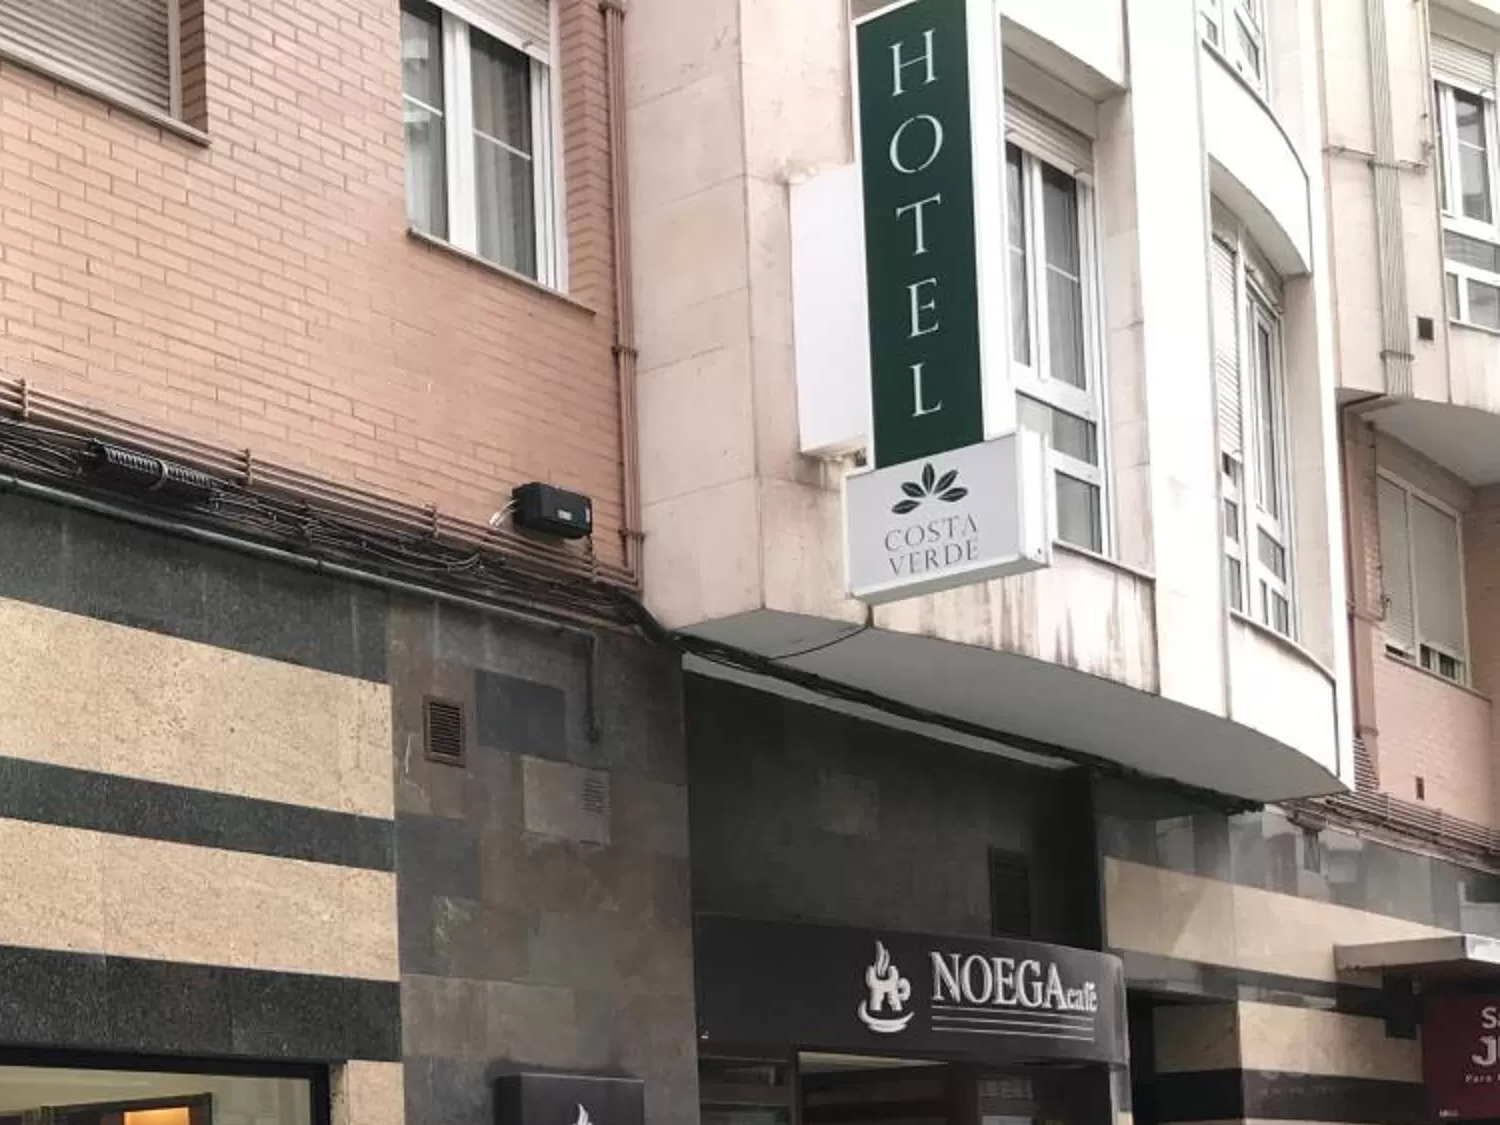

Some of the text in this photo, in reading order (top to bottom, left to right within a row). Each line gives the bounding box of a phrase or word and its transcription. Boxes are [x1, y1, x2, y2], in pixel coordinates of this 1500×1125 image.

[889, 29, 943, 418] HOTEL
[884, 514, 978, 552] COSTA
[888, 540, 980, 577] VERDE
